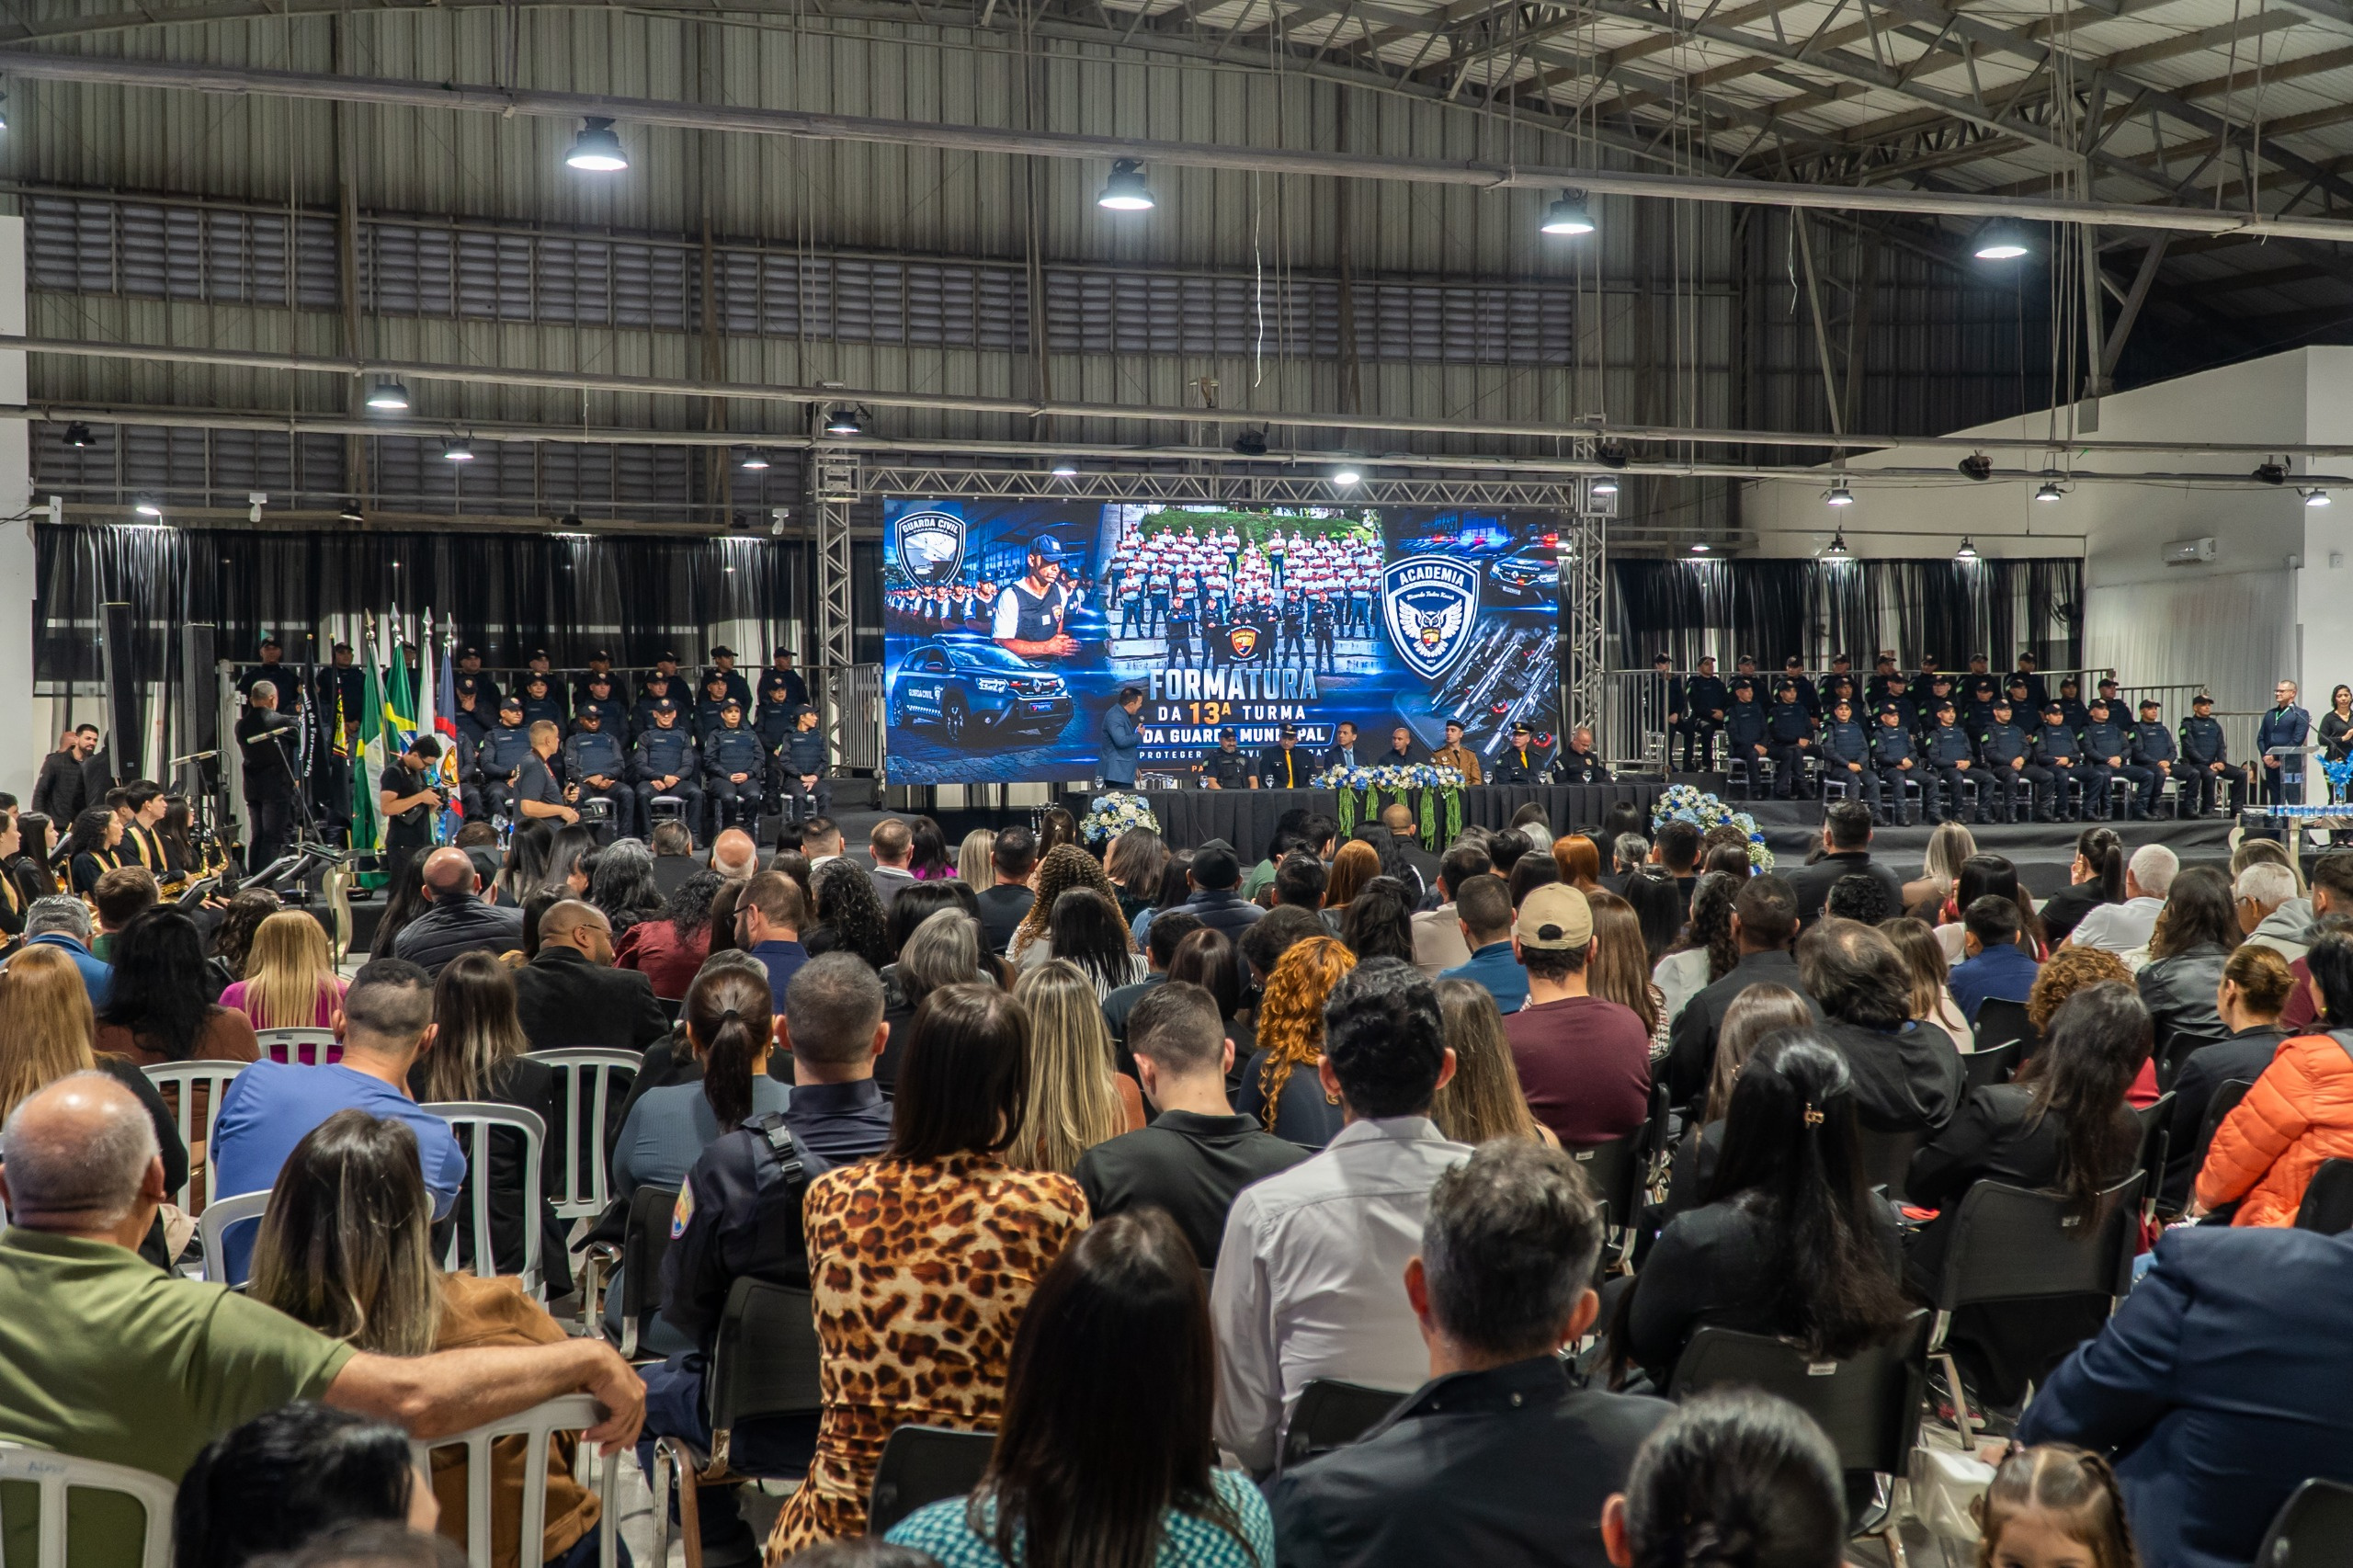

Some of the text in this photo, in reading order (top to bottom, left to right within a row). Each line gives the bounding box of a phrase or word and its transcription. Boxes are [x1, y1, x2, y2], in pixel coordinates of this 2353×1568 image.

[902, 518, 959, 534] GUARDA CIVIL
[1399, 565, 1465, 587] ACADEMIA
[1149, 668, 1318, 700] FORMATURA
[308, 711, 316, 725] de
[1157, 706, 1182, 722] DA
[1242, 705, 1306, 721] TURMA
[1142, 728, 1325, 744] DA GUARD MUNIPAL
[1139, 750, 1202, 759] PROTEGER
